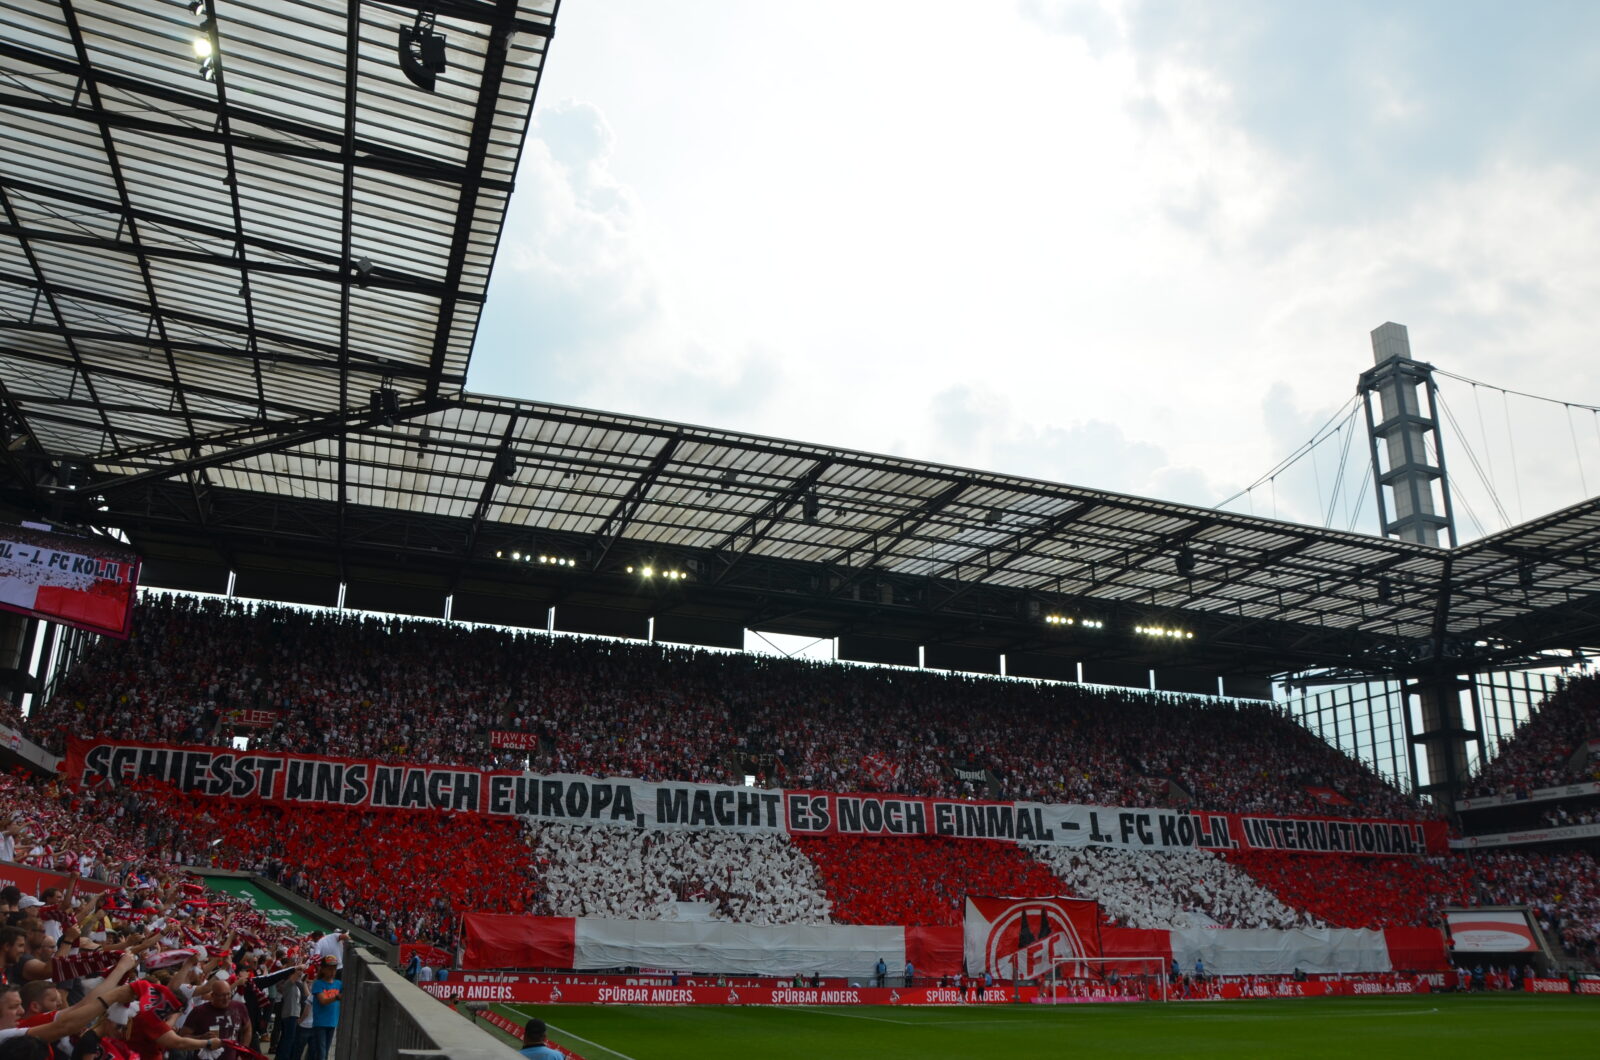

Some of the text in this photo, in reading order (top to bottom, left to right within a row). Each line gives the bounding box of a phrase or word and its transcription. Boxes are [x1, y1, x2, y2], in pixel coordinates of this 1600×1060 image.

[30, 550, 43, 565] 1.
[48, 553, 70, 570] FC
[72, 557, 122, 584] KÖLN,
[491, 731, 537, 747] HAWKS
[503, 742, 525, 750] KÖLN
[953, 768, 987, 782] TROIKA
[80, 745, 284, 799] SCHIESST
[285, 759, 369, 806] UNS
[371, 765, 481, 812] NACH
[489, 774, 645, 828] EUROPA,
[655, 787, 781, 828] MACHT
[788, 793, 832, 832] ES
[837, 797, 926, 835] NOCH
[933, 803, 1055, 842] EINMAL
[1088, 810, 1113, 842] 1.
[1119, 813, 1154, 845] FC
[1158, 810, 1240, 850] KÖLN,
[1241, 817, 1427, 856] INTERNATIONAL!
[467, 985, 515, 999] ANDERS.
[598, 986, 696, 1002] SPÜRBAR ANDERS.
[1353, 981, 1384, 995] SPÜRBA
[771, 988, 861, 1003] SPÜRBAR ANDERS.
[971, 990, 1008, 1002] ADERS.
